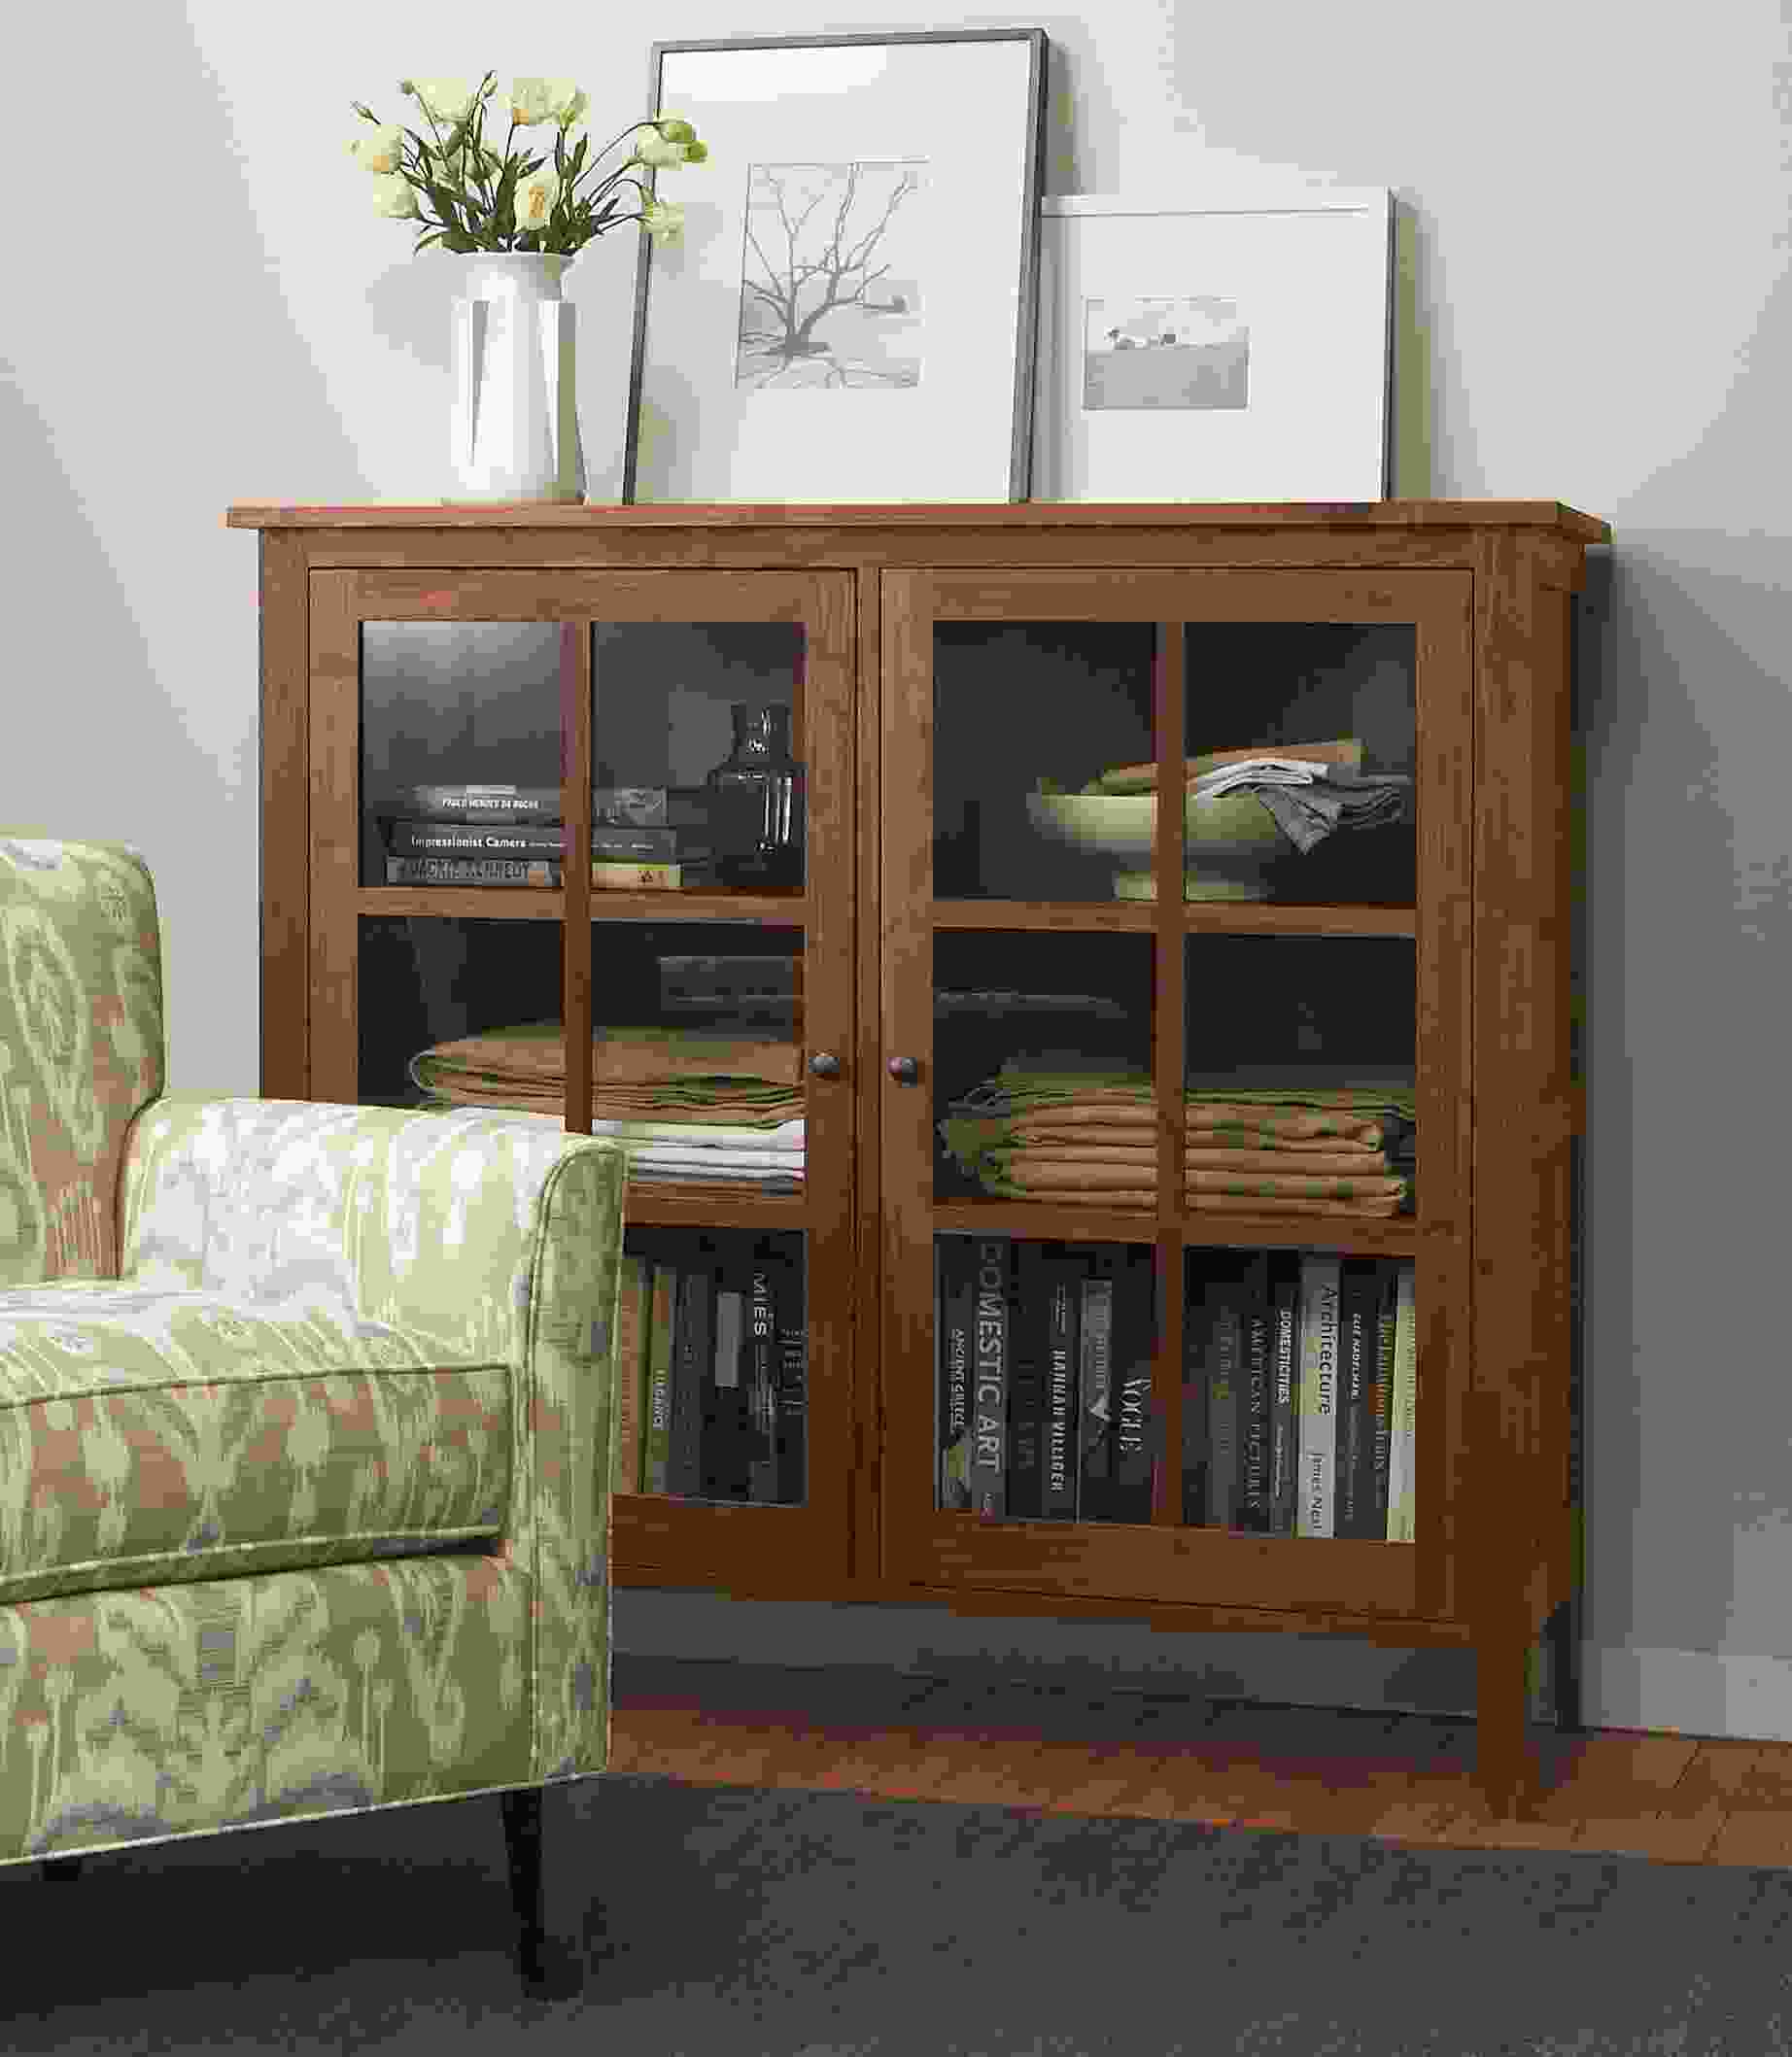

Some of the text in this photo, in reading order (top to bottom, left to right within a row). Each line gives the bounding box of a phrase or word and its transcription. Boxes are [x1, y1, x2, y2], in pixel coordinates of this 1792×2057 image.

[411, 833, 483, 849] Impressionist
[485, 833, 527, 848] Camera
[753, 1272, 769, 1337] MIES
[977, 1244, 1005, 1406] DOMESTIC
[1318, 1284, 1338, 1416] Architecture
[977, 1414, 1002, 1474] ART
[1119, 1377, 1149, 1455] VOGUE
